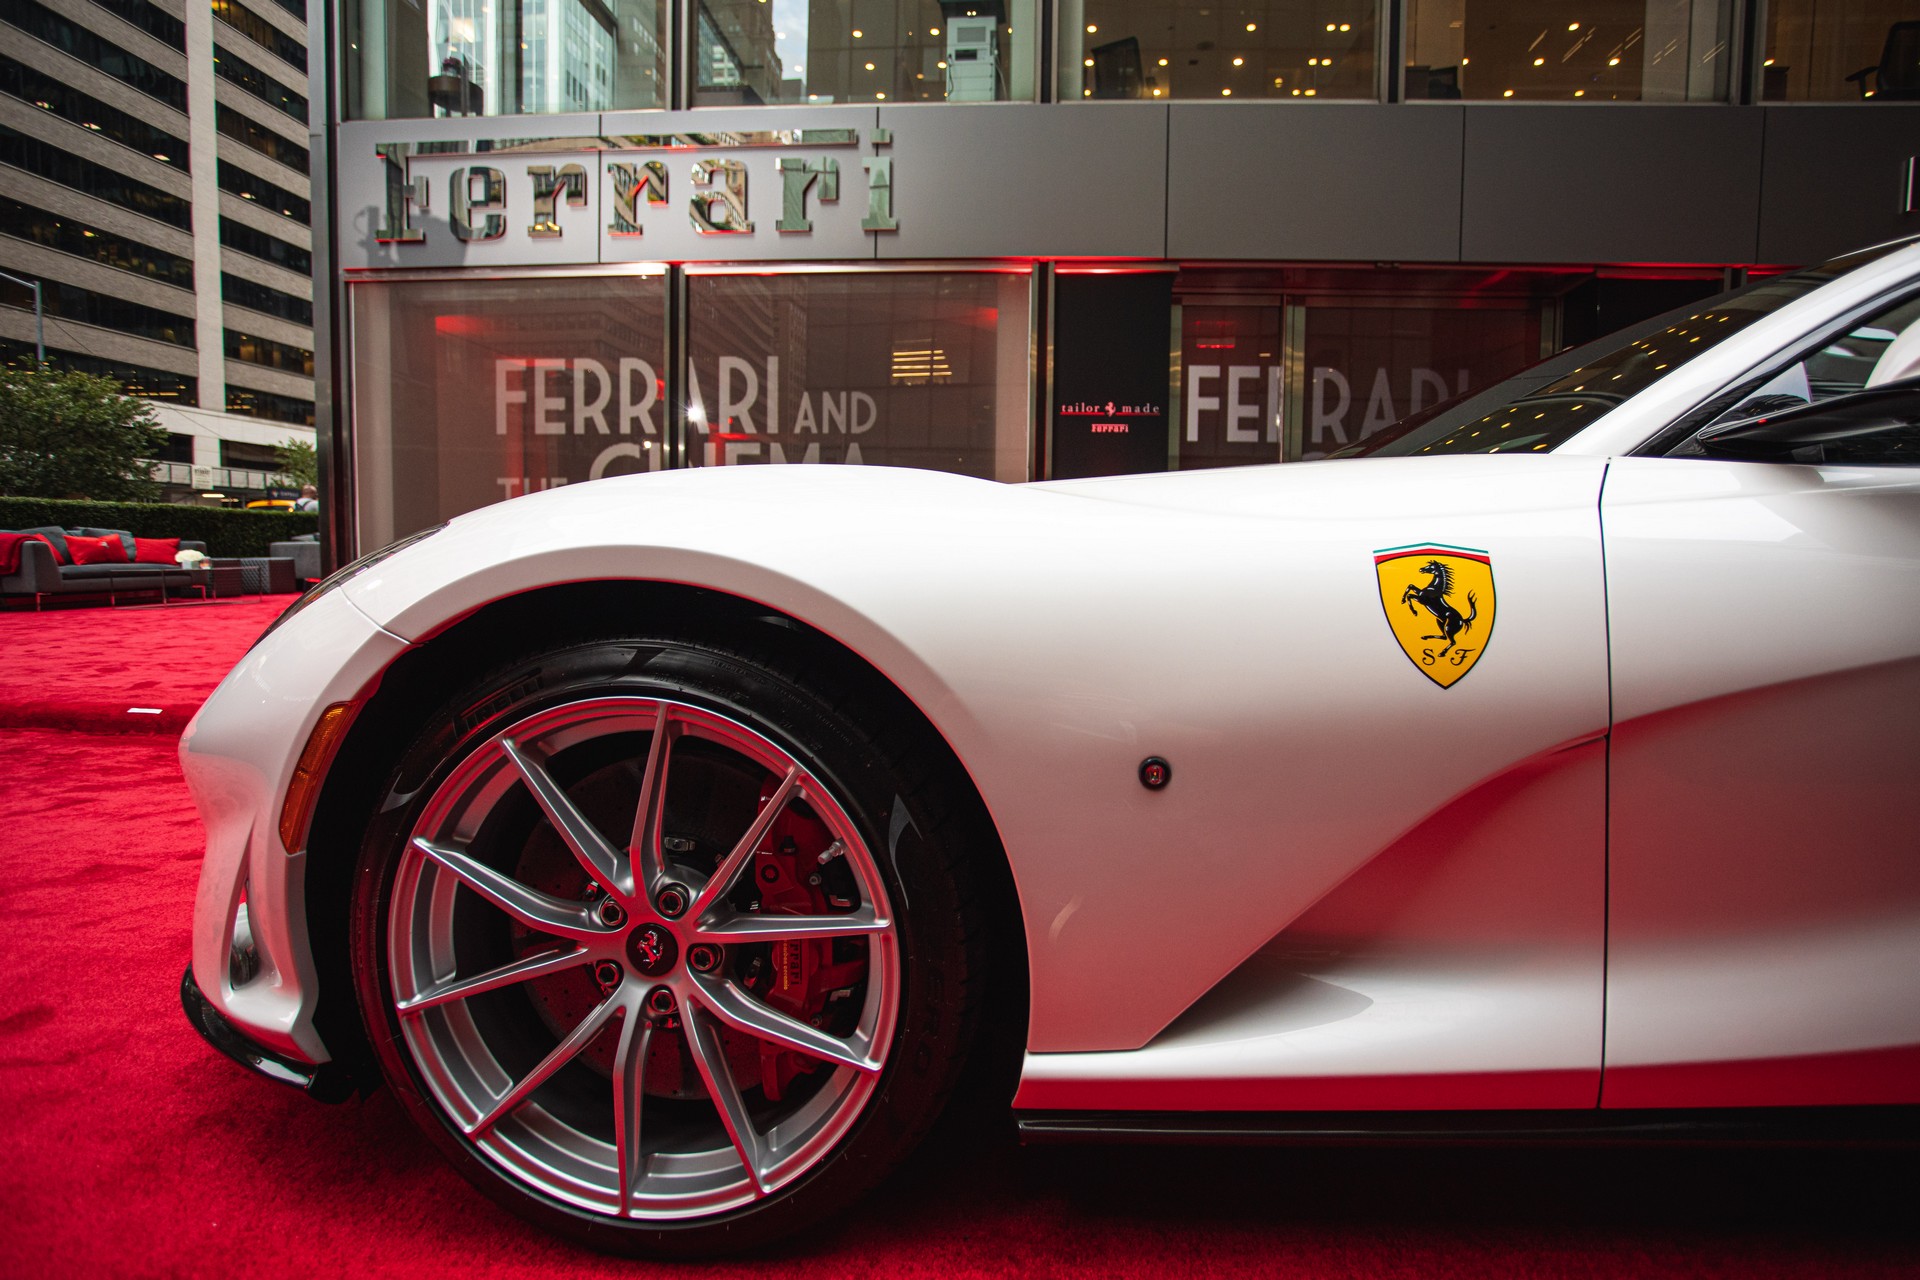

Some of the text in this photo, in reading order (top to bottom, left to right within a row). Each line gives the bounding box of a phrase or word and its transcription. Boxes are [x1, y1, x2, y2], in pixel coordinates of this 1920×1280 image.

[375, 127, 898, 243] Ferrari
[794, 390, 878, 434] AND
[1061, 402, 1160, 413] tailor made
[1091, 423, 1129, 433] Ferrari
[1422, 648, 1477, 666] S F
